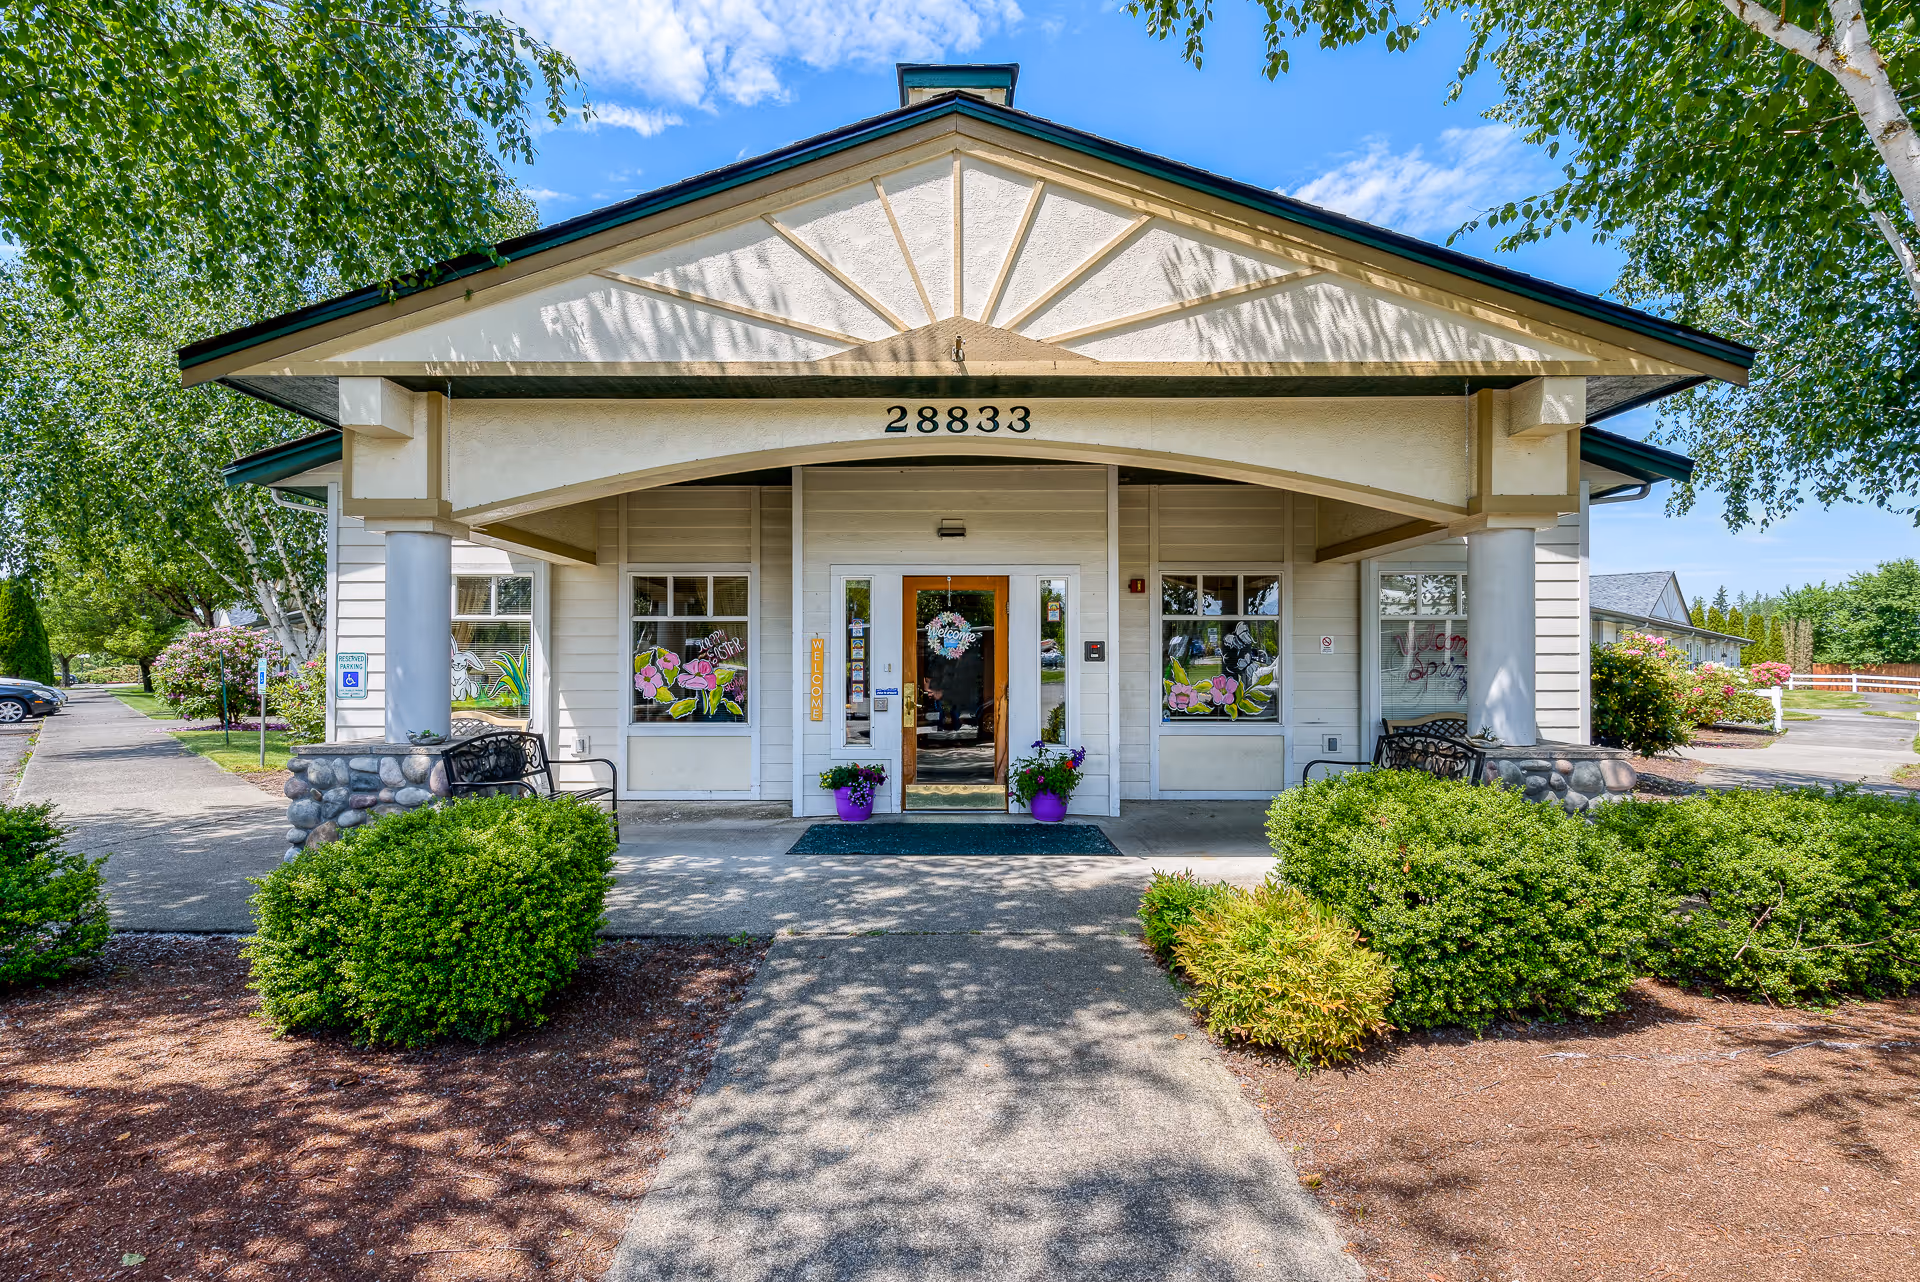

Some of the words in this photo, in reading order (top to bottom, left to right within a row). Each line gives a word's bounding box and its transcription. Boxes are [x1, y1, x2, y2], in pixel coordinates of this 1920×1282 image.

[885, 405, 1031, 433] 28833
[925, 624, 976, 642] Welcome
[1395, 623, 1467, 655] Welcom
[811, 640, 822, 719] WELCOME
